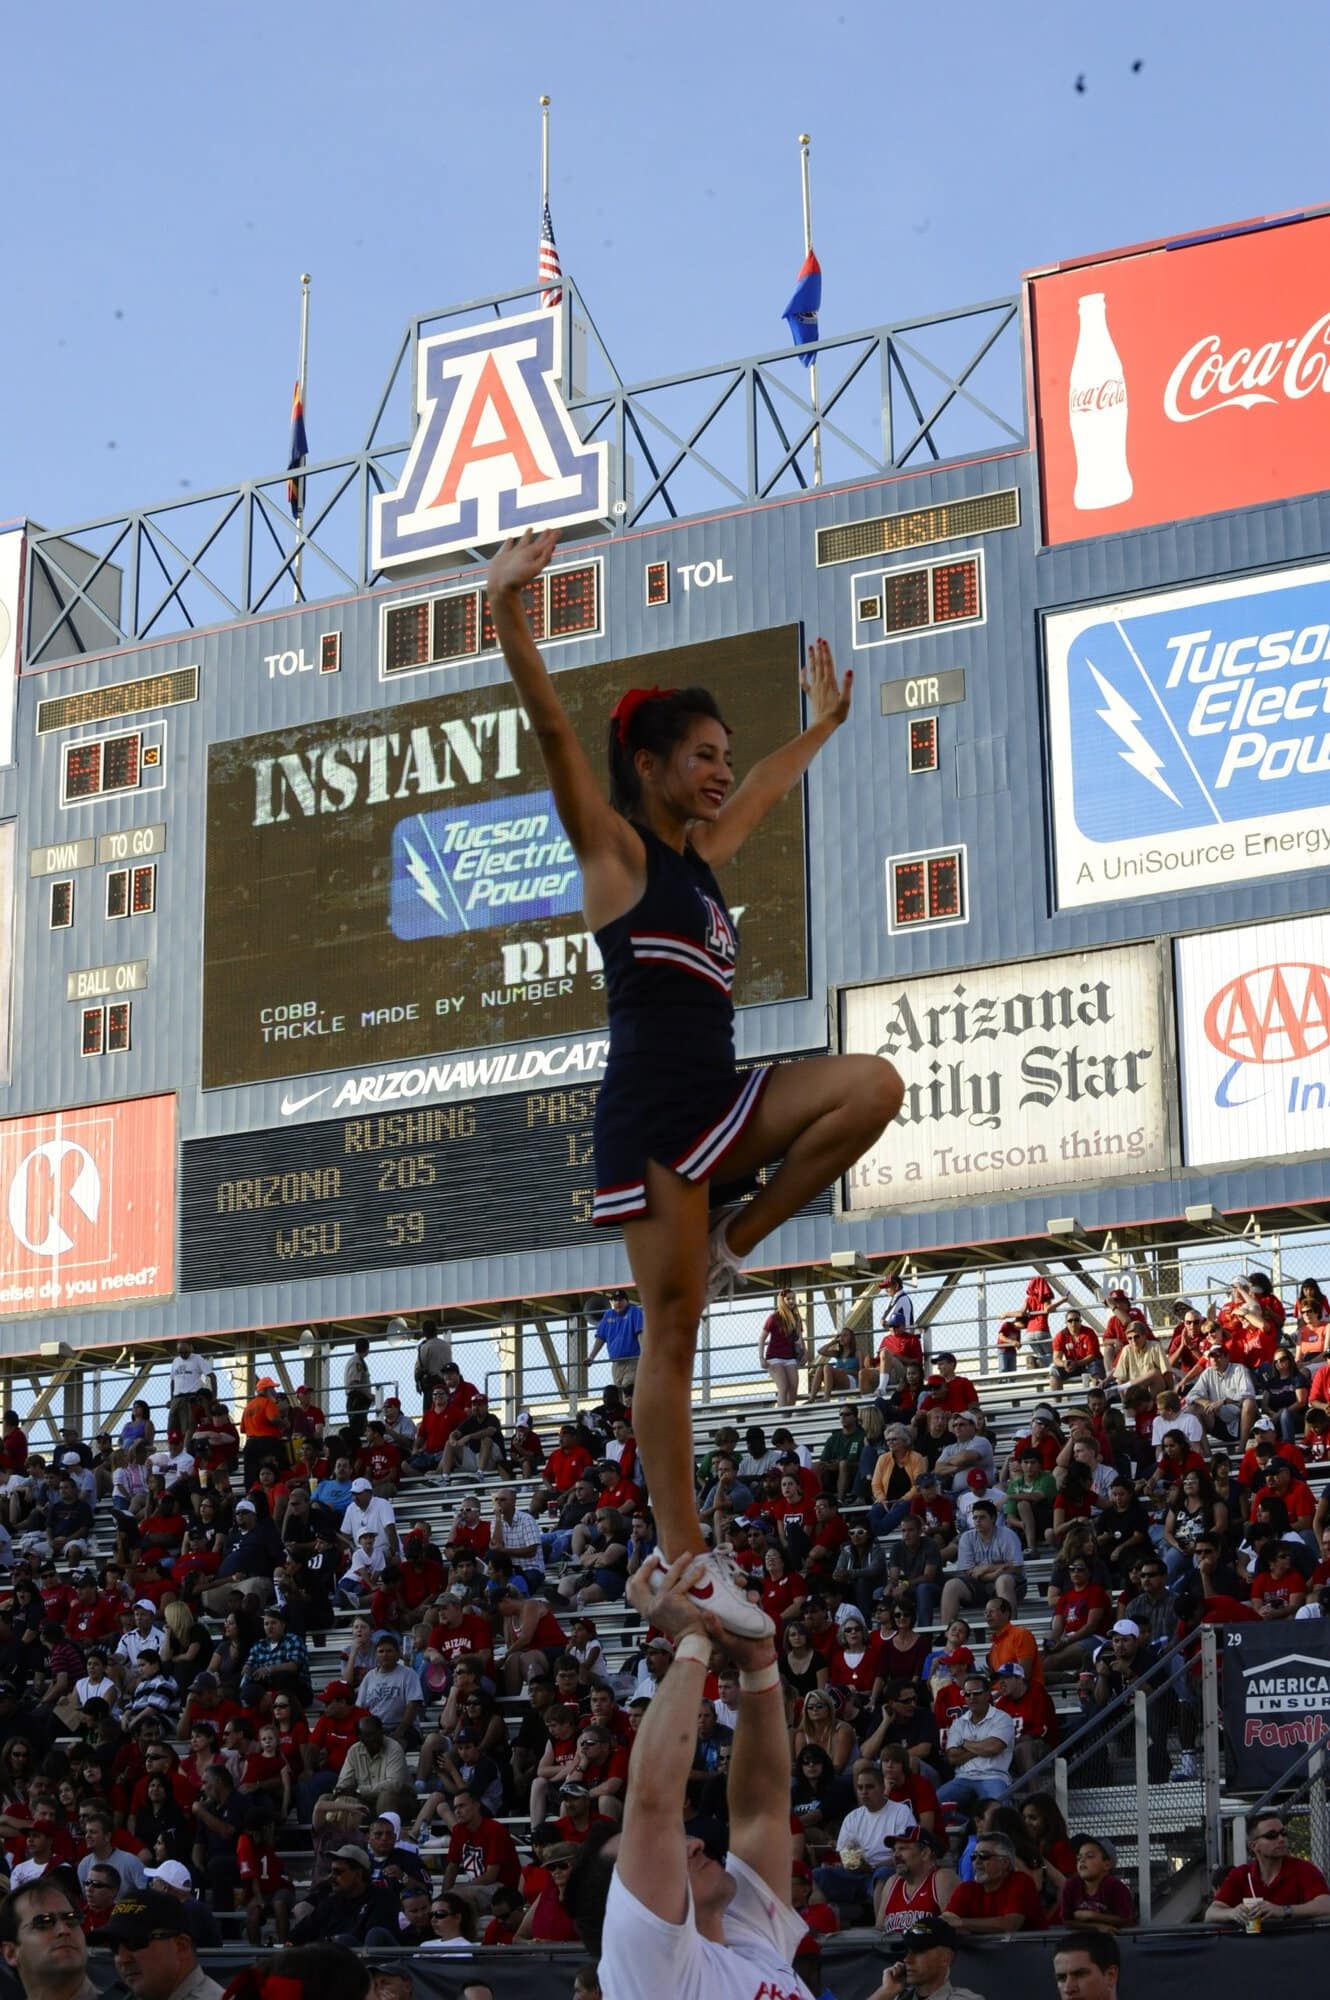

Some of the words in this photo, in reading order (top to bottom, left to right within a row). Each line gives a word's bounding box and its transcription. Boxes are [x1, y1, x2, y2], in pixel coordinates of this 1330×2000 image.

[883, 507, 947, 550] WSU
[677, 559, 733, 591] TOL
[264, 648, 313, 679] TOL
[1165, 622, 1330, 689] Tucso
[905, 677, 939, 708] QTR
[252, 707, 531, 826] INSTANT
[110, 834, 128, 859] TO
[133, 828, 154, 855] GO
[442, 814, 549, 854] Tucson
[46, 845, 78, 871] DWN
[453, 836, 576, 881] Electric
[1076, 862, 1094, 885] A
[1103, 842, 1235, 881] UniSource
[465, 870, 577, 911] Power
[77, 973, 110, 998] BALL
[115, 965, 136, 990] ON
[260, 1000, 326, 1025] COBB.
[261, 1015, 346, 1043] TACKLE
[361, 1003, 420, 1028] MADE
[436, 996, 465, 1016] BY
[481, 978, 574, 1008] NUMBER
[876, 981, 1115, 1056] Arizona
[892, 1060, 1002, 1130] aily
[1019, 1045, 1155, 1111] Star
[1287, 1075, 1330, 1114] In
[344, 1105, 477, 1153] RUSHING
[904, 1160, 922, 1181] a
[933, 1144, 1048, 1177] Tucson
[1060, 1127, 1155, 1160] thing.
[217, 1167, 341, 1213] ARIZONA
[378, 1153, 436, 1191] 205
[276, 1222, 341, 1260] WSU
[386, 1211, 425, 1247] 59
[572, 1189, 597, 1222] 5
[65, 1279, 97, 1299] you
[101, 1266, 159, 1291] need?
[1227, 1632, 1242, 1647] 29
[1246, 1676, 1330, 1695] AMERICA
